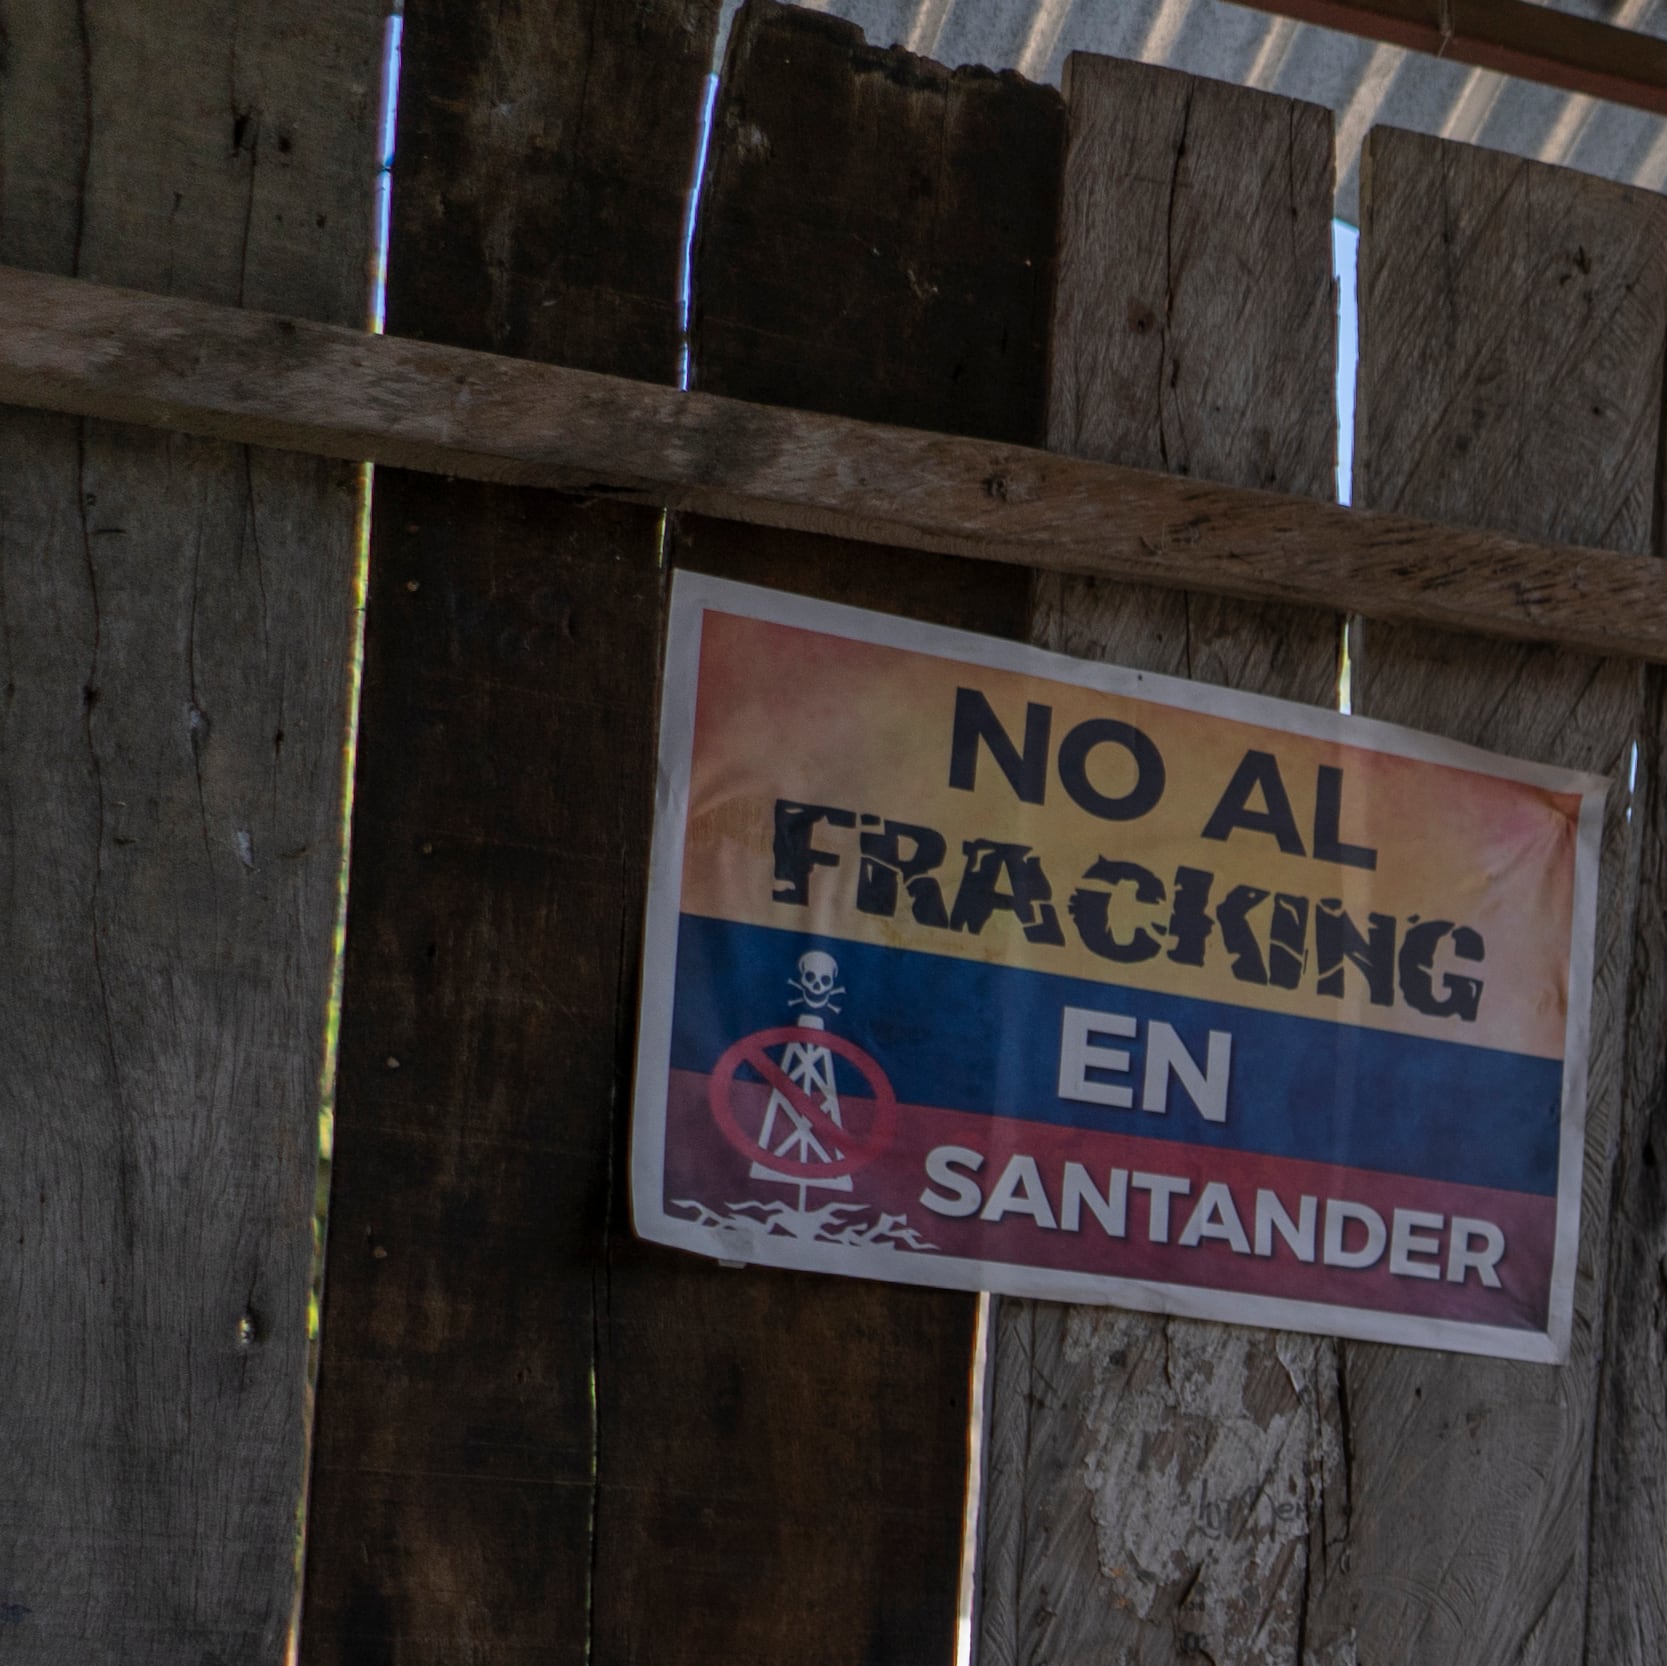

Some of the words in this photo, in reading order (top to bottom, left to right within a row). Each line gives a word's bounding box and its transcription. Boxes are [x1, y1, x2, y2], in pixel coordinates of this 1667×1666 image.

[948, 686, 1166, 822] NO
[1201, 749, 1378, 871] AL
[771, 798, 1486, 1023] FRACKING
[1057, 1005, 1232, 1123] EN
[919, 1145, 1506, 1288] SANTANDER
